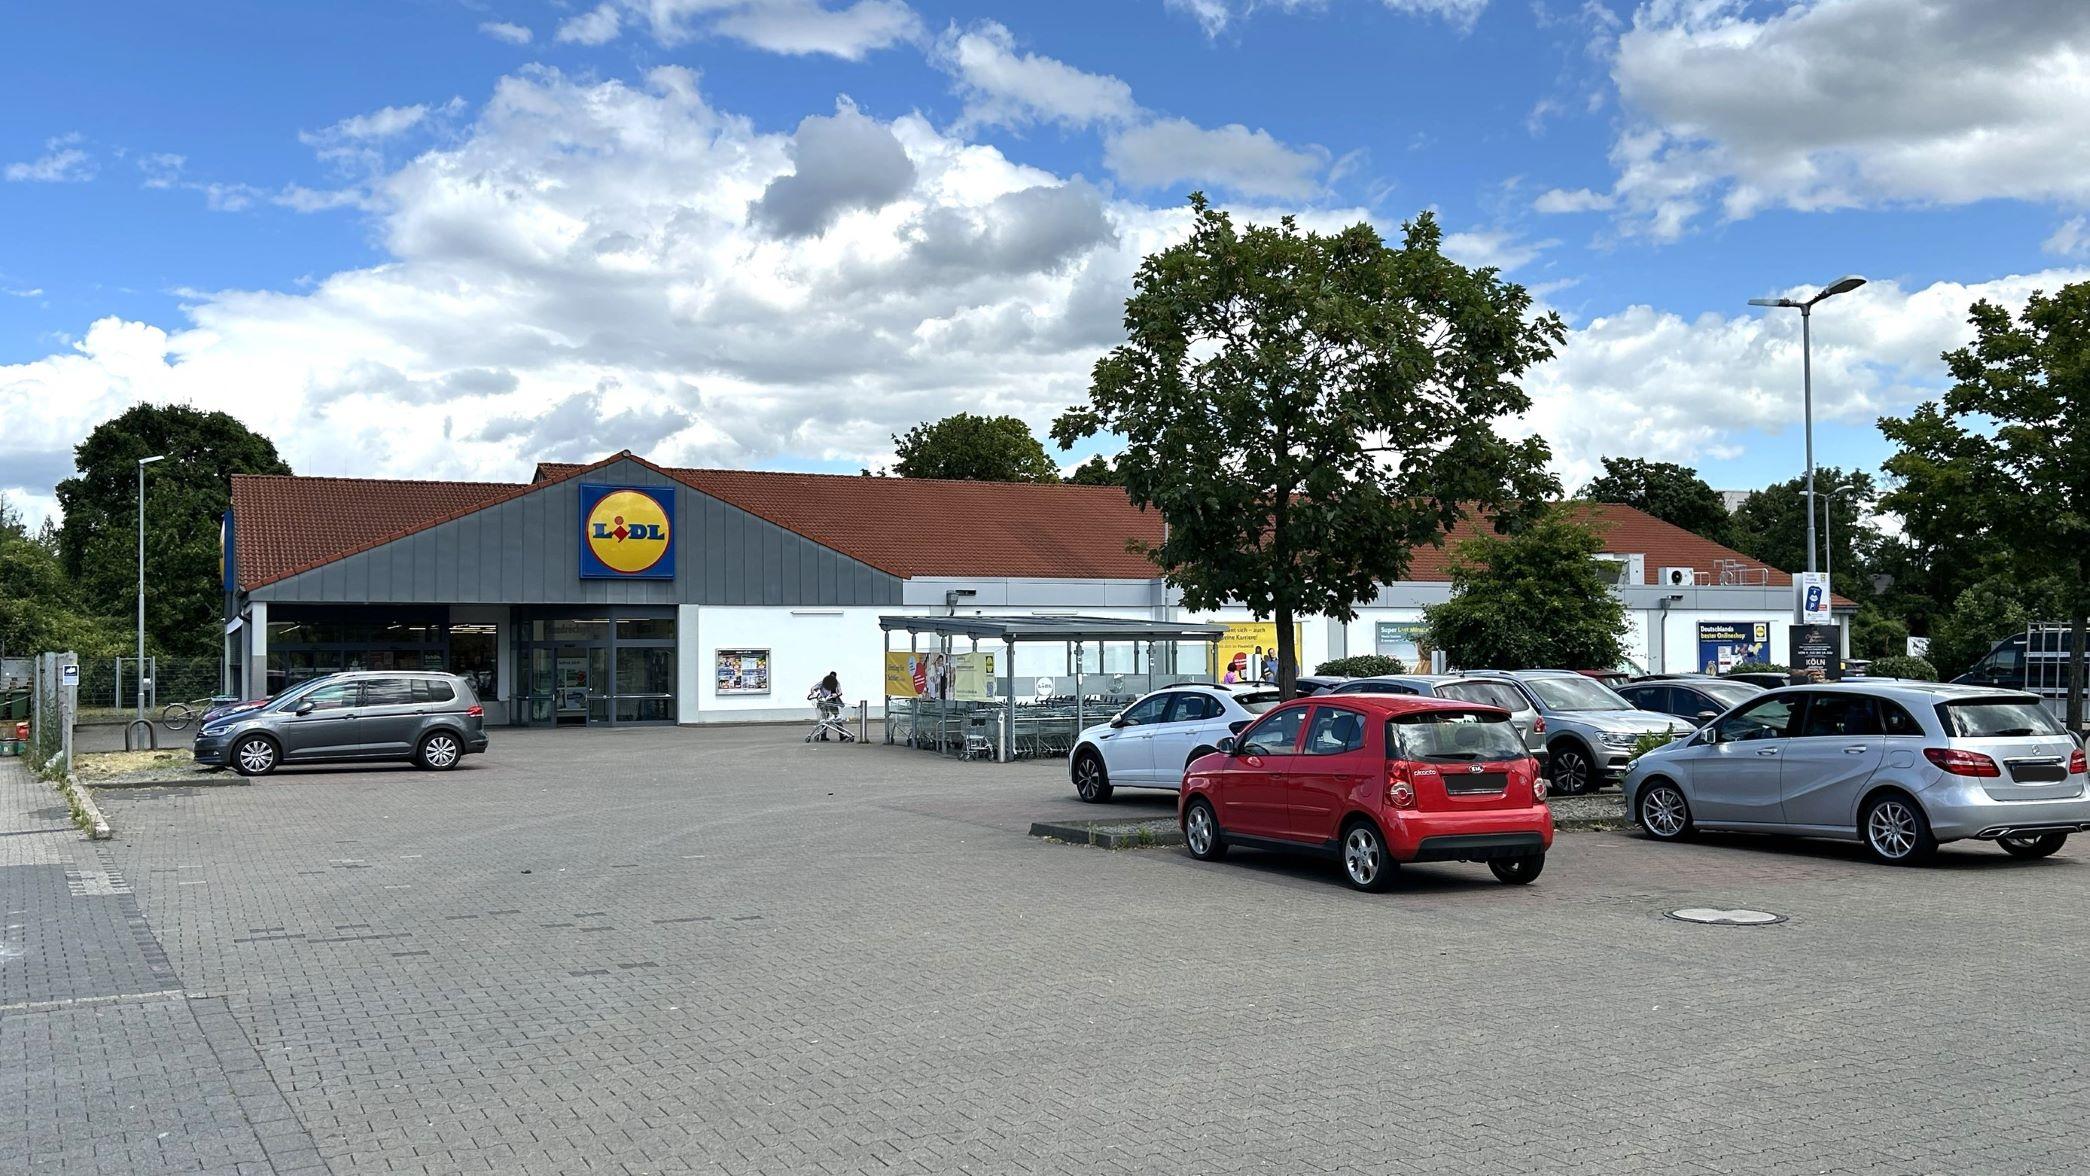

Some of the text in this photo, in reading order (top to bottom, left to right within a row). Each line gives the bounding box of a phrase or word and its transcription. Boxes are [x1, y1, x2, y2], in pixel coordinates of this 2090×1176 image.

[593, 515, 665, 543] LIDL
[1381, 626, 1397, 634] Super
[1717, 632, 1745, 640] Onlineshop
